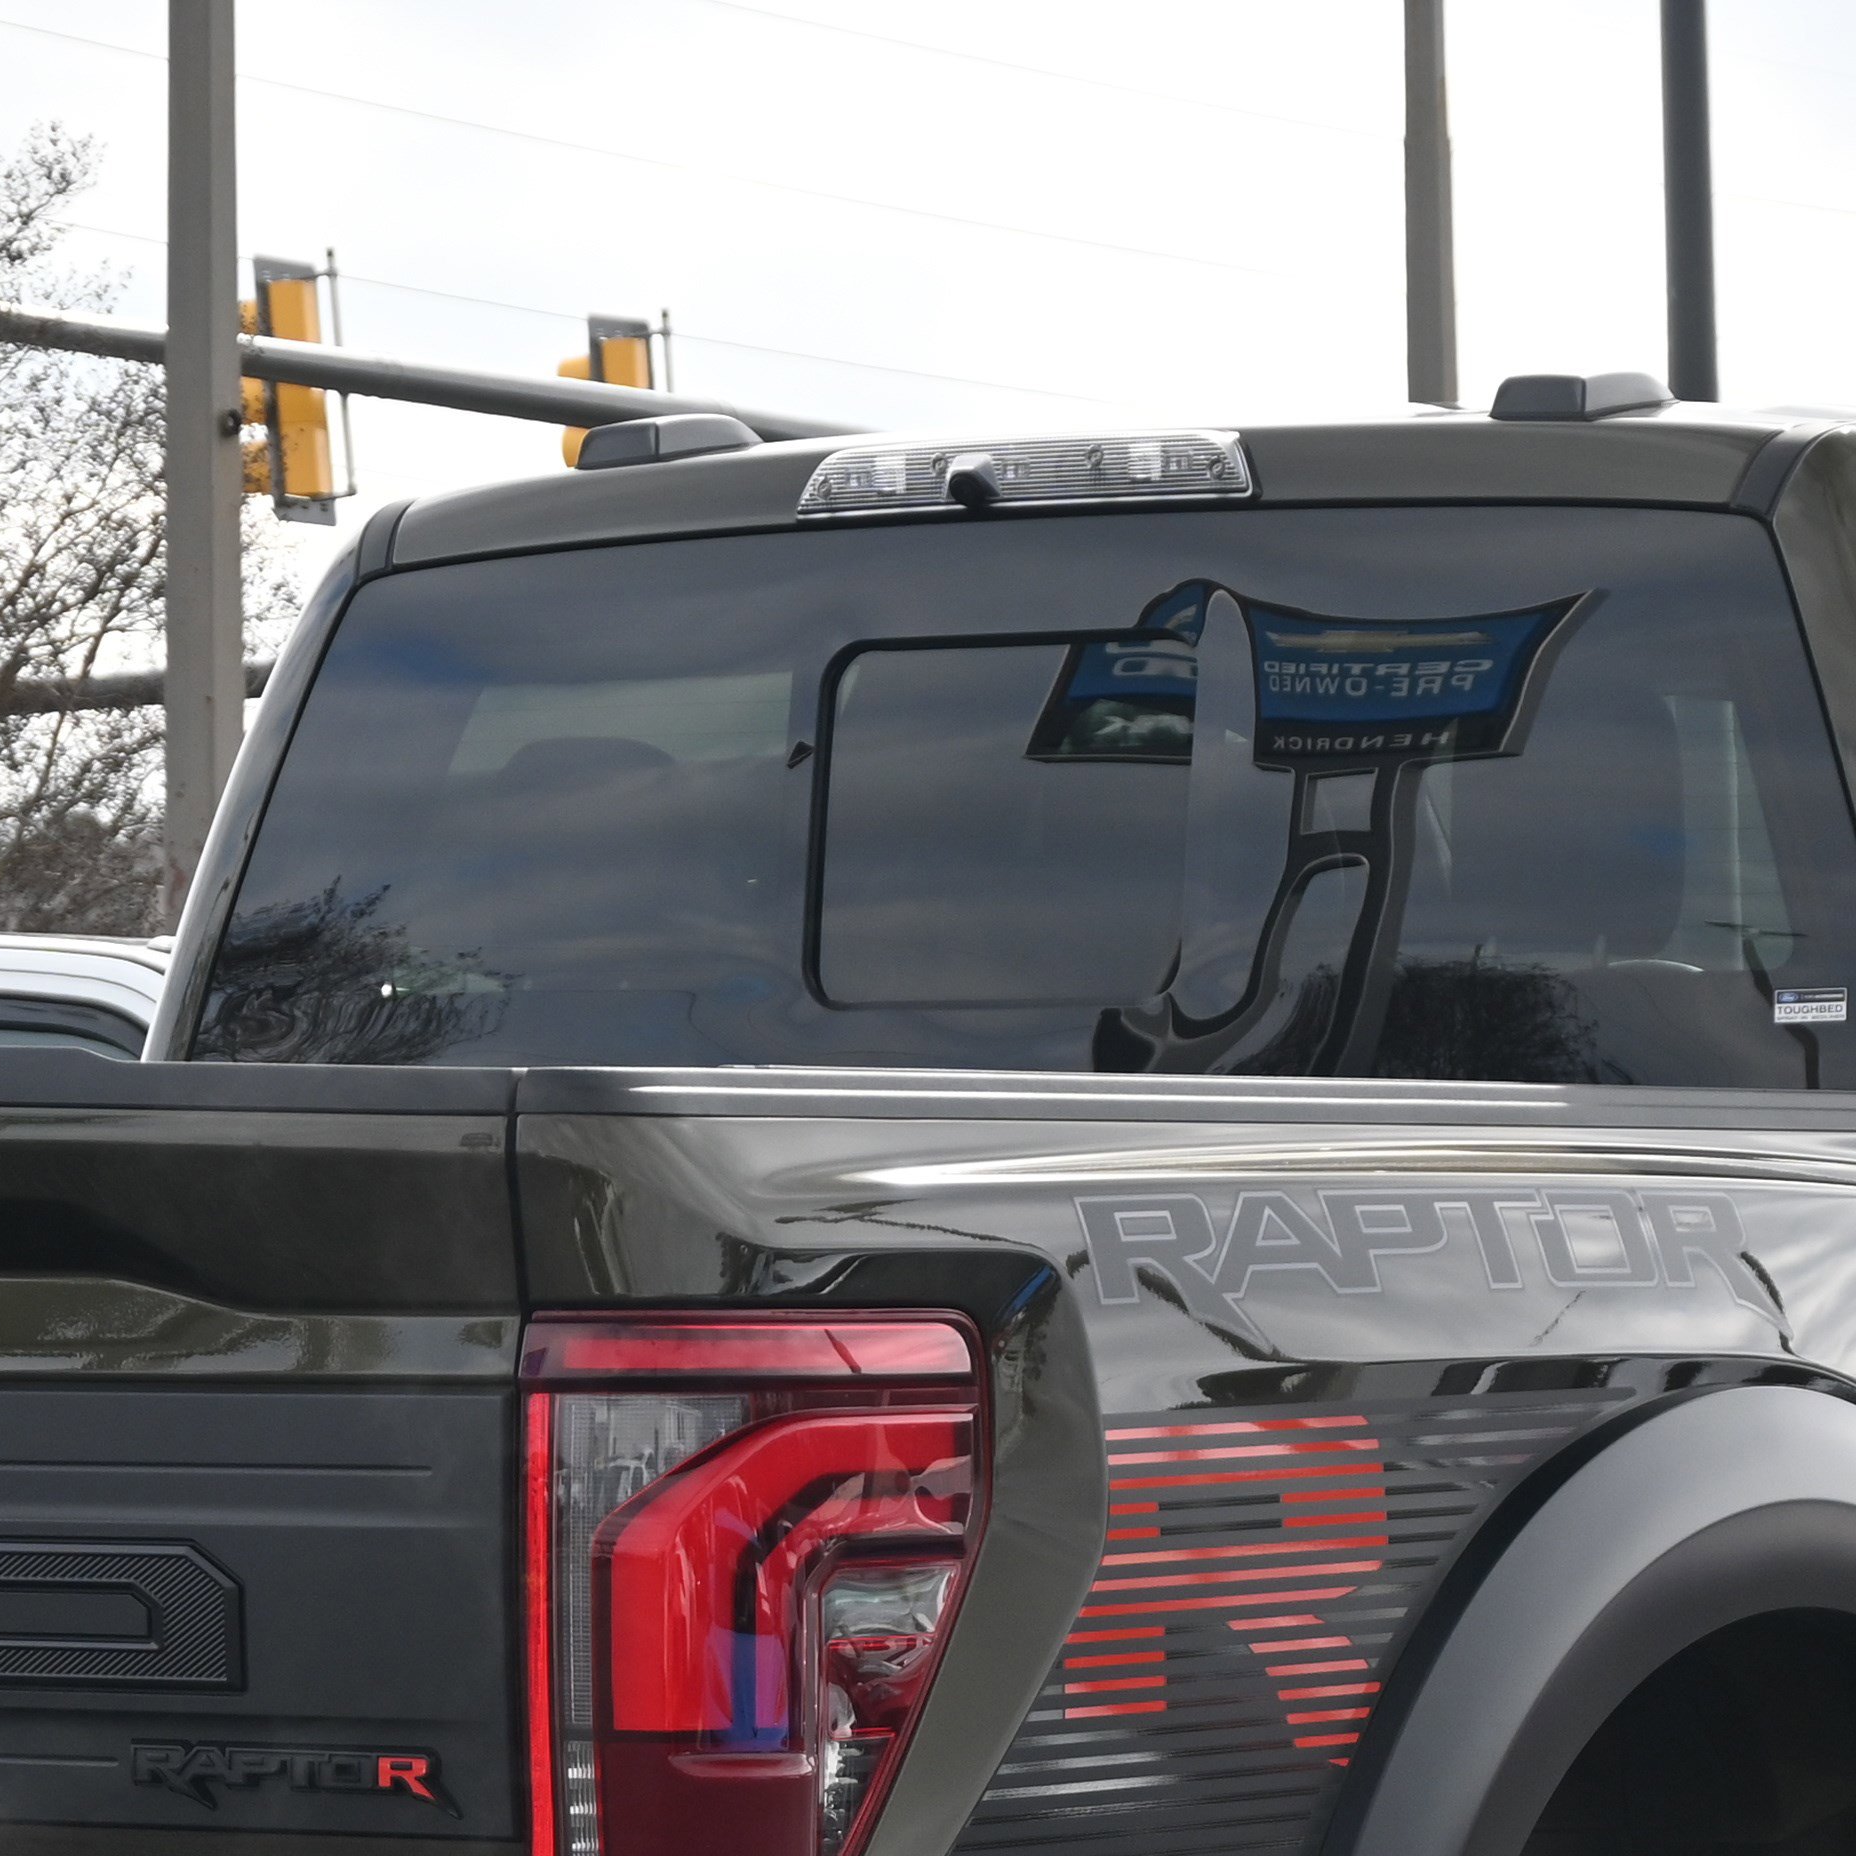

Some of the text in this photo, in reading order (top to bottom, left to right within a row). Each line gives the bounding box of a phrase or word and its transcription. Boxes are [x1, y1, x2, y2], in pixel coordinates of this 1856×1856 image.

[1777, 1004, 1844, 1015] TOUGHBED
[1073, 1188, 1796, 1356] RAPTOR
[130, 1738, 461, 1819] RAPTOR
